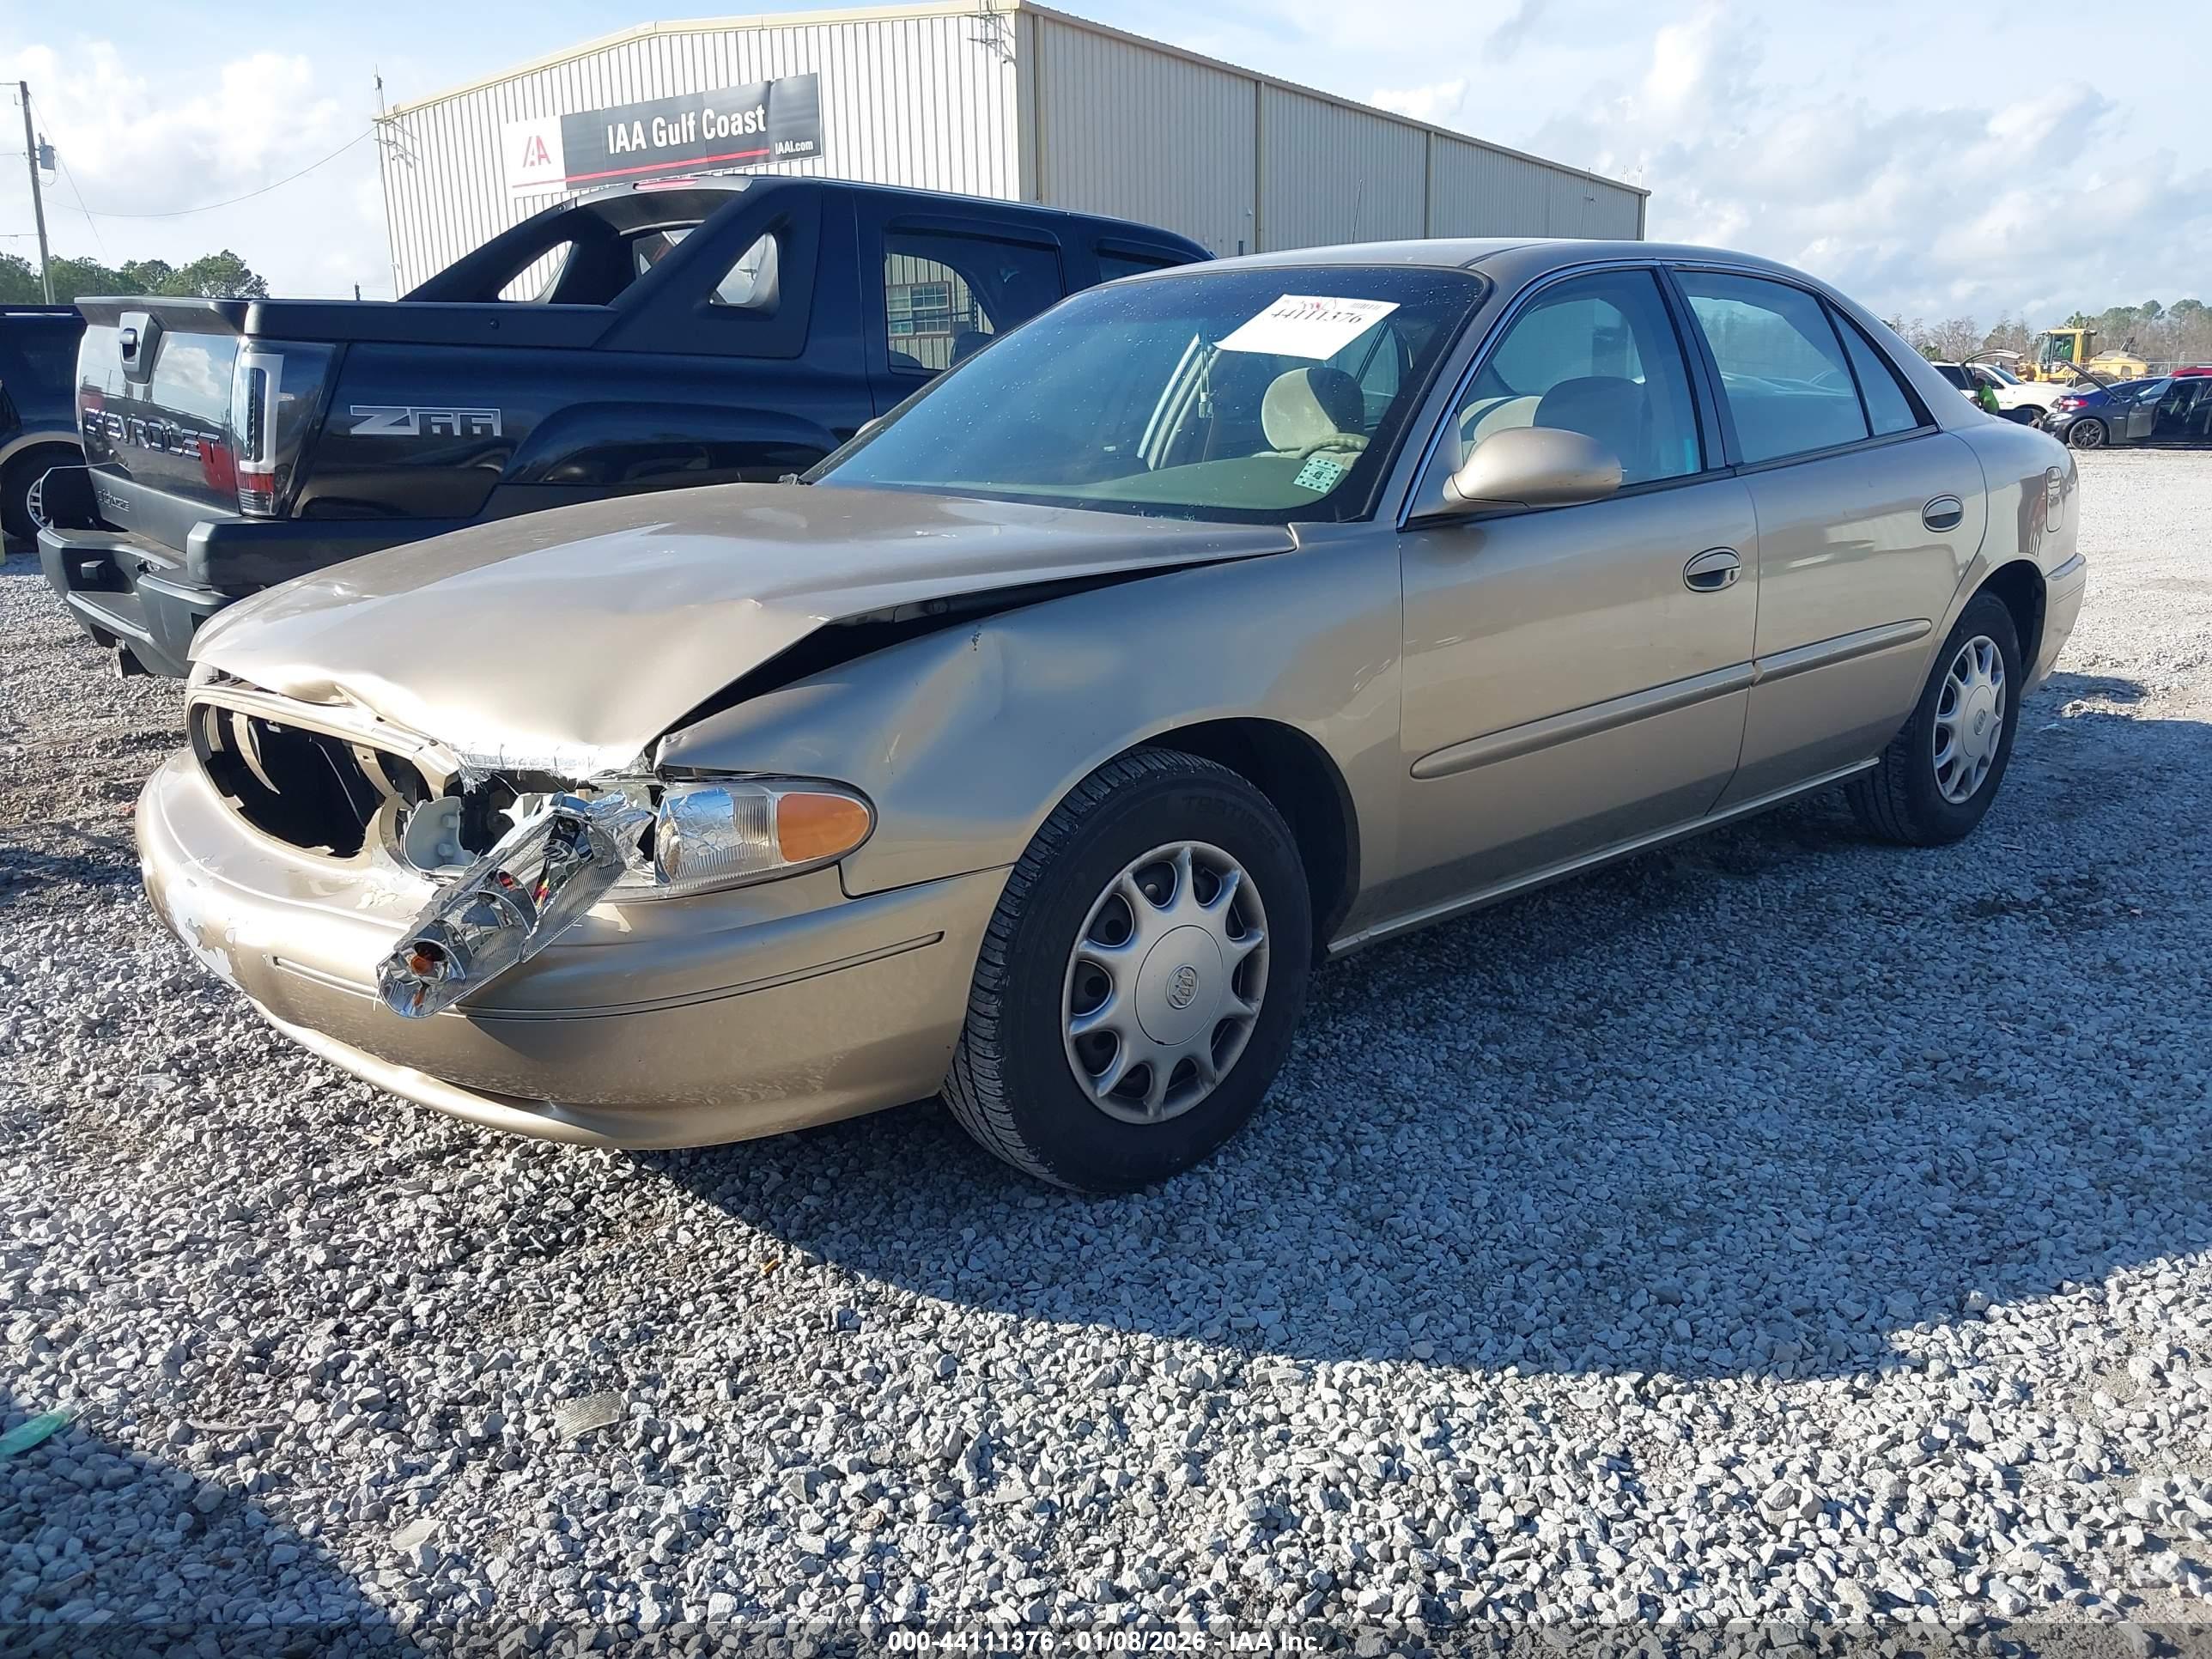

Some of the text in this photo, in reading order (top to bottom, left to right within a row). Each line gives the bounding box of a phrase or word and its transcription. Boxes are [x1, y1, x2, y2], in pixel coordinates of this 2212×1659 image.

[607, 103, 766, 154] IAA Gulf Coast
[775, 139, 814, 155] IAAI.com
[1271, 308, 1366, 324] 44111376
